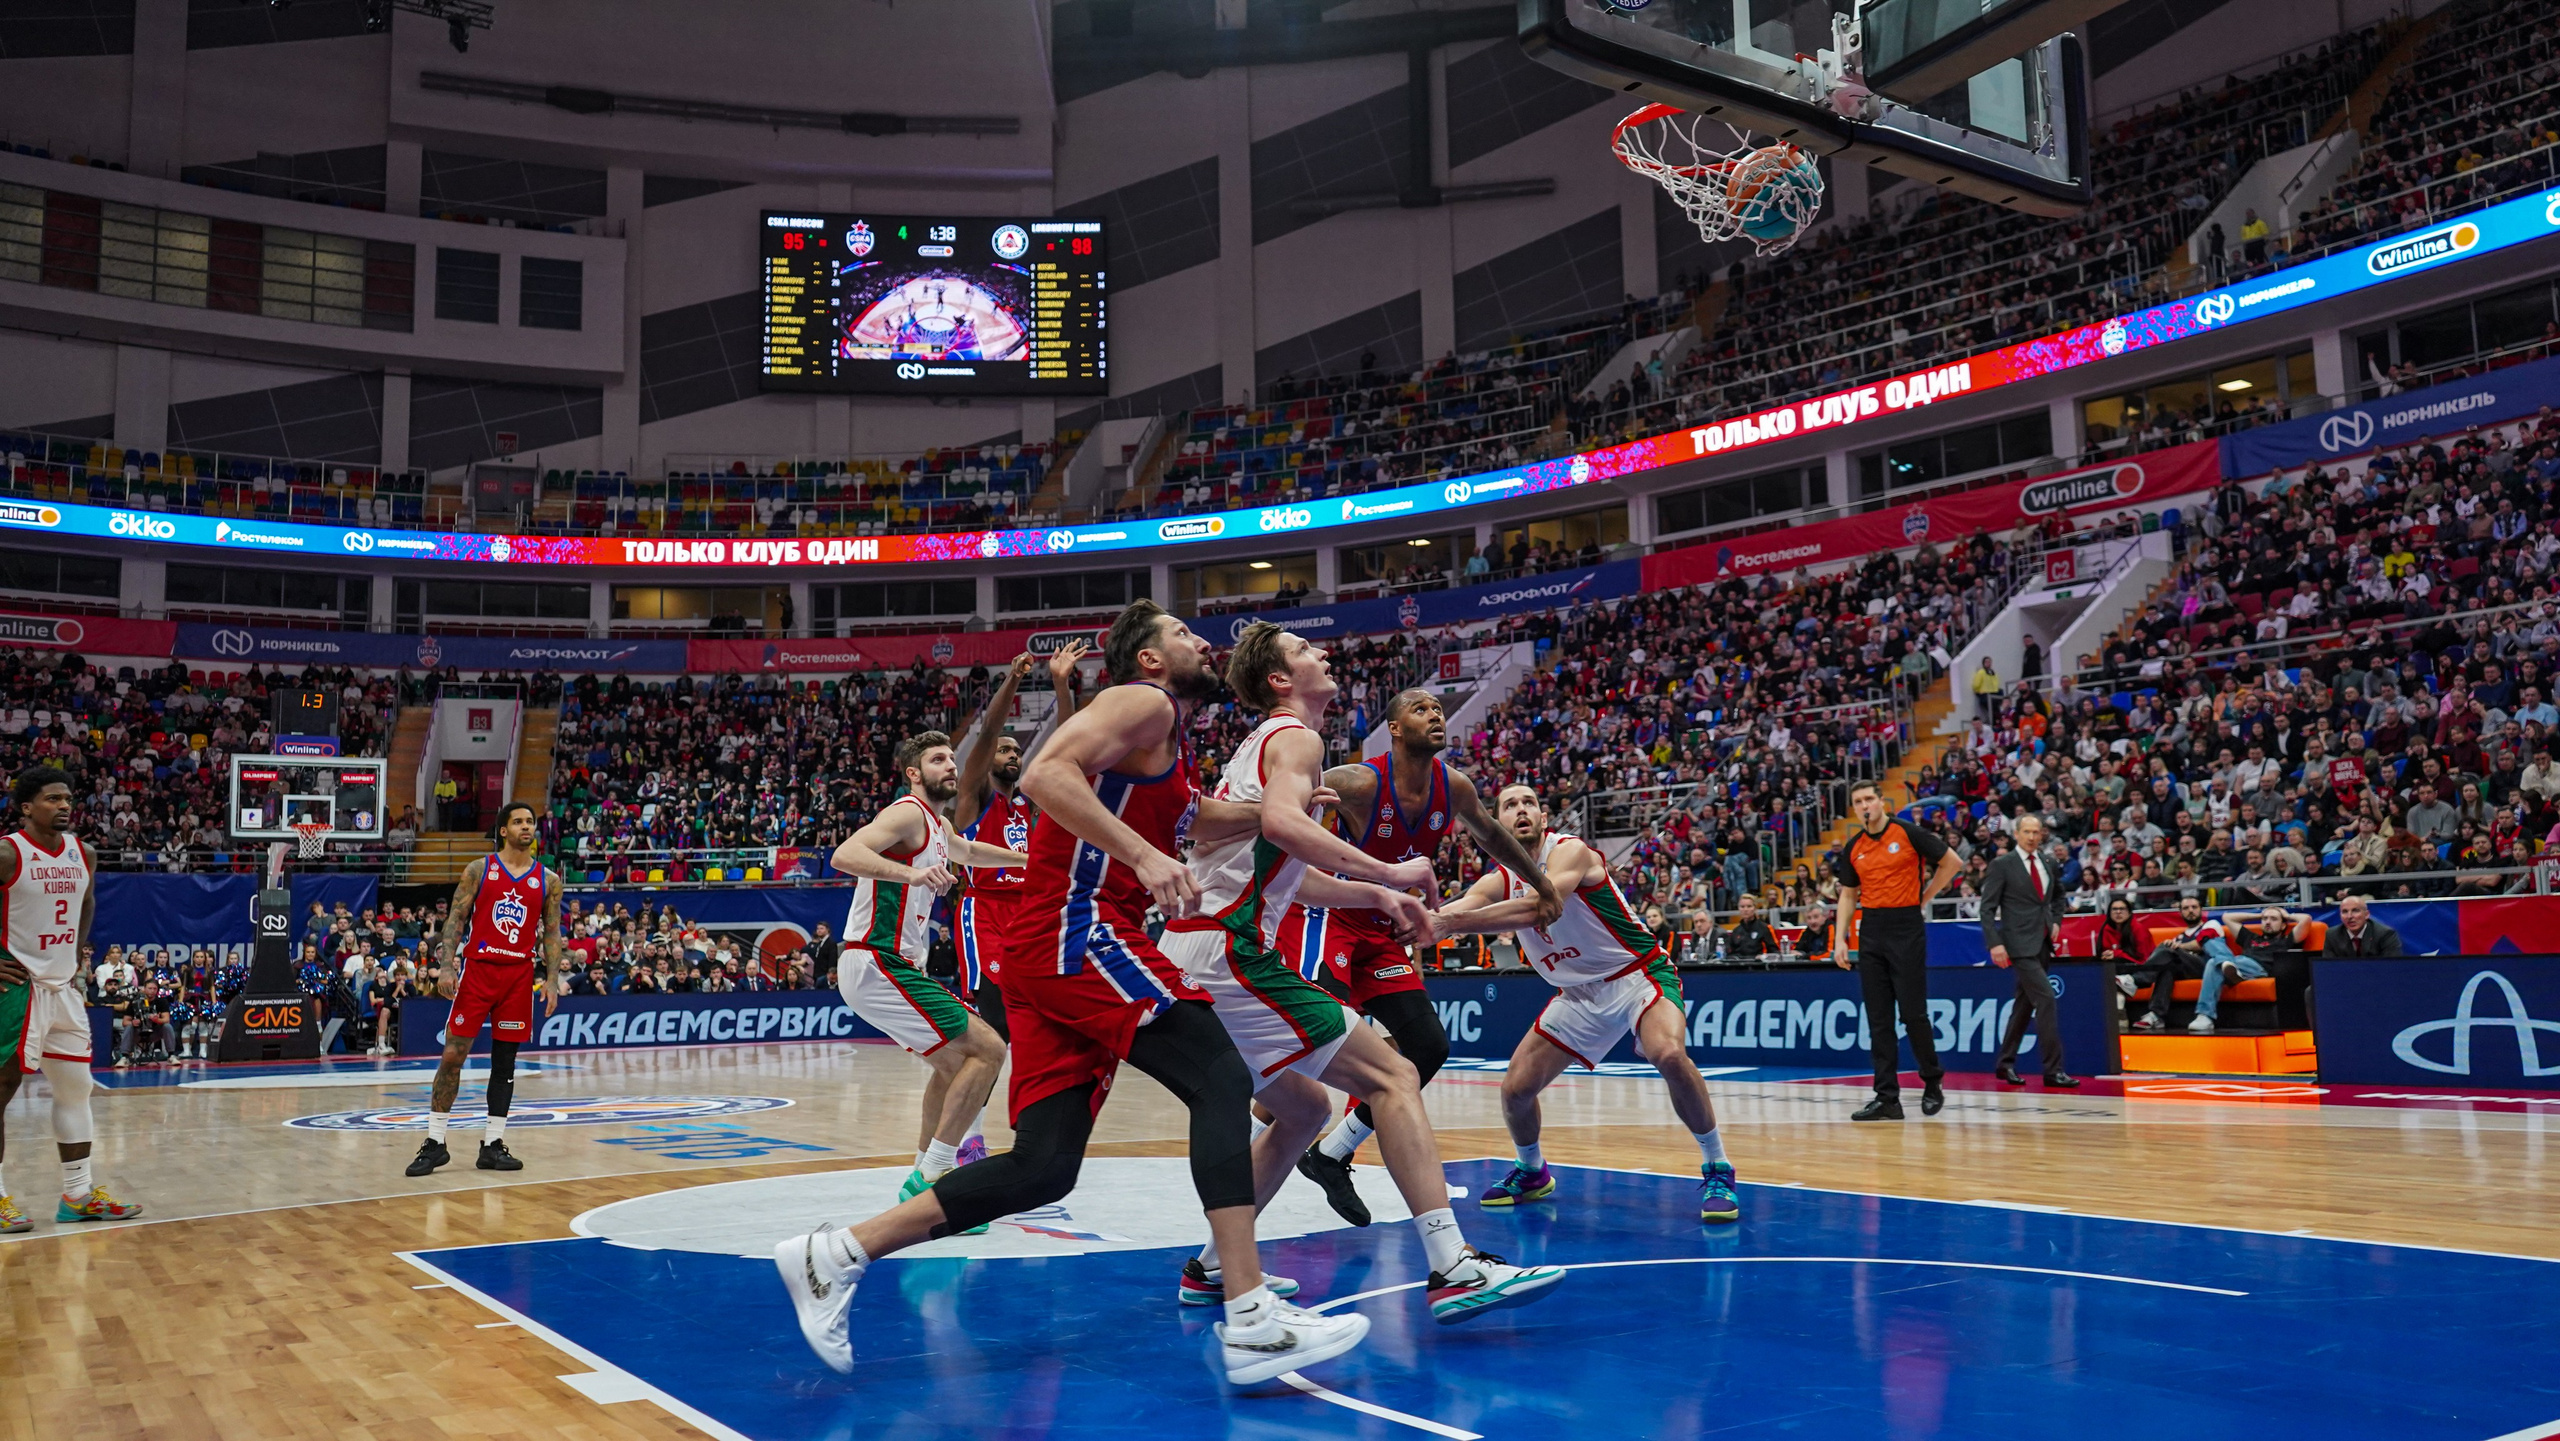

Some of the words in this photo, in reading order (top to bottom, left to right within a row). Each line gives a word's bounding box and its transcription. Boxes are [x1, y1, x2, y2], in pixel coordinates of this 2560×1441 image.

[767, 217, 788, 227] CSKA
[789, 218, 824, 228] MOSCOW
[783, 232, 804, 250] 95
[898, 226, 907, 240] 4
[930, 226, 956, 241] 1:38
[1072, 238, 1092, 255] 98
[2375, 236, 2448, 269] Winline
[765, 257, 771, 265] 2
[765, 266, 771, 274] 3
[2239, 277, 2315, 307] НОРНИКЕЛЬ
[1691, 408, 1796, 455] ТОЛЬКО
[1803, 386, 1880, 431] КЛУБ
[1884, 363, 1971, 410] ОДИН
[2383, 392, 2495, 429] НОРНИКЕЛЬ
[2031, 476, 2108, 508] Winline
[1354, 499, 1414, 518] Ростелеком
[1165, 523, 1206, 537] Winline
[232, 531, 303, 546] Ростелеком
[622, 540, 725, 563] ТОЛЬКО
[732, 541, 801, 566] КЛУБ
[808, 539, 879, 564] ОДИН
[1734, 543, 1821, 568] Ростелеком
[1479, 583, 1570, 607] АЭРОФЛОТ
[1274, 616, 1334, 631] ОРНИКЕЛЬ
[260, 638, 340, 653] НОРНИКЕЛЬ
[509, 646, 610, 660] АЭРОФЛОТ
[780, 651, 860, 664] Ростелеком
[302, 693, 324, 709] 1.3
[285, 745, 320, 755] Winline
[30, 867, 83, 880] LOKOMOTIV
[44, 881, 76, 894] KUBAN
[55, 900, 68, 925] 2
[498, 906, 522, 918] CSKA
[508, 928, 520, 944] 6
[243, 1007, 302, 1028] GMS
[539, 1005, 854, 1046] АКАДЕМСЕРВИС
